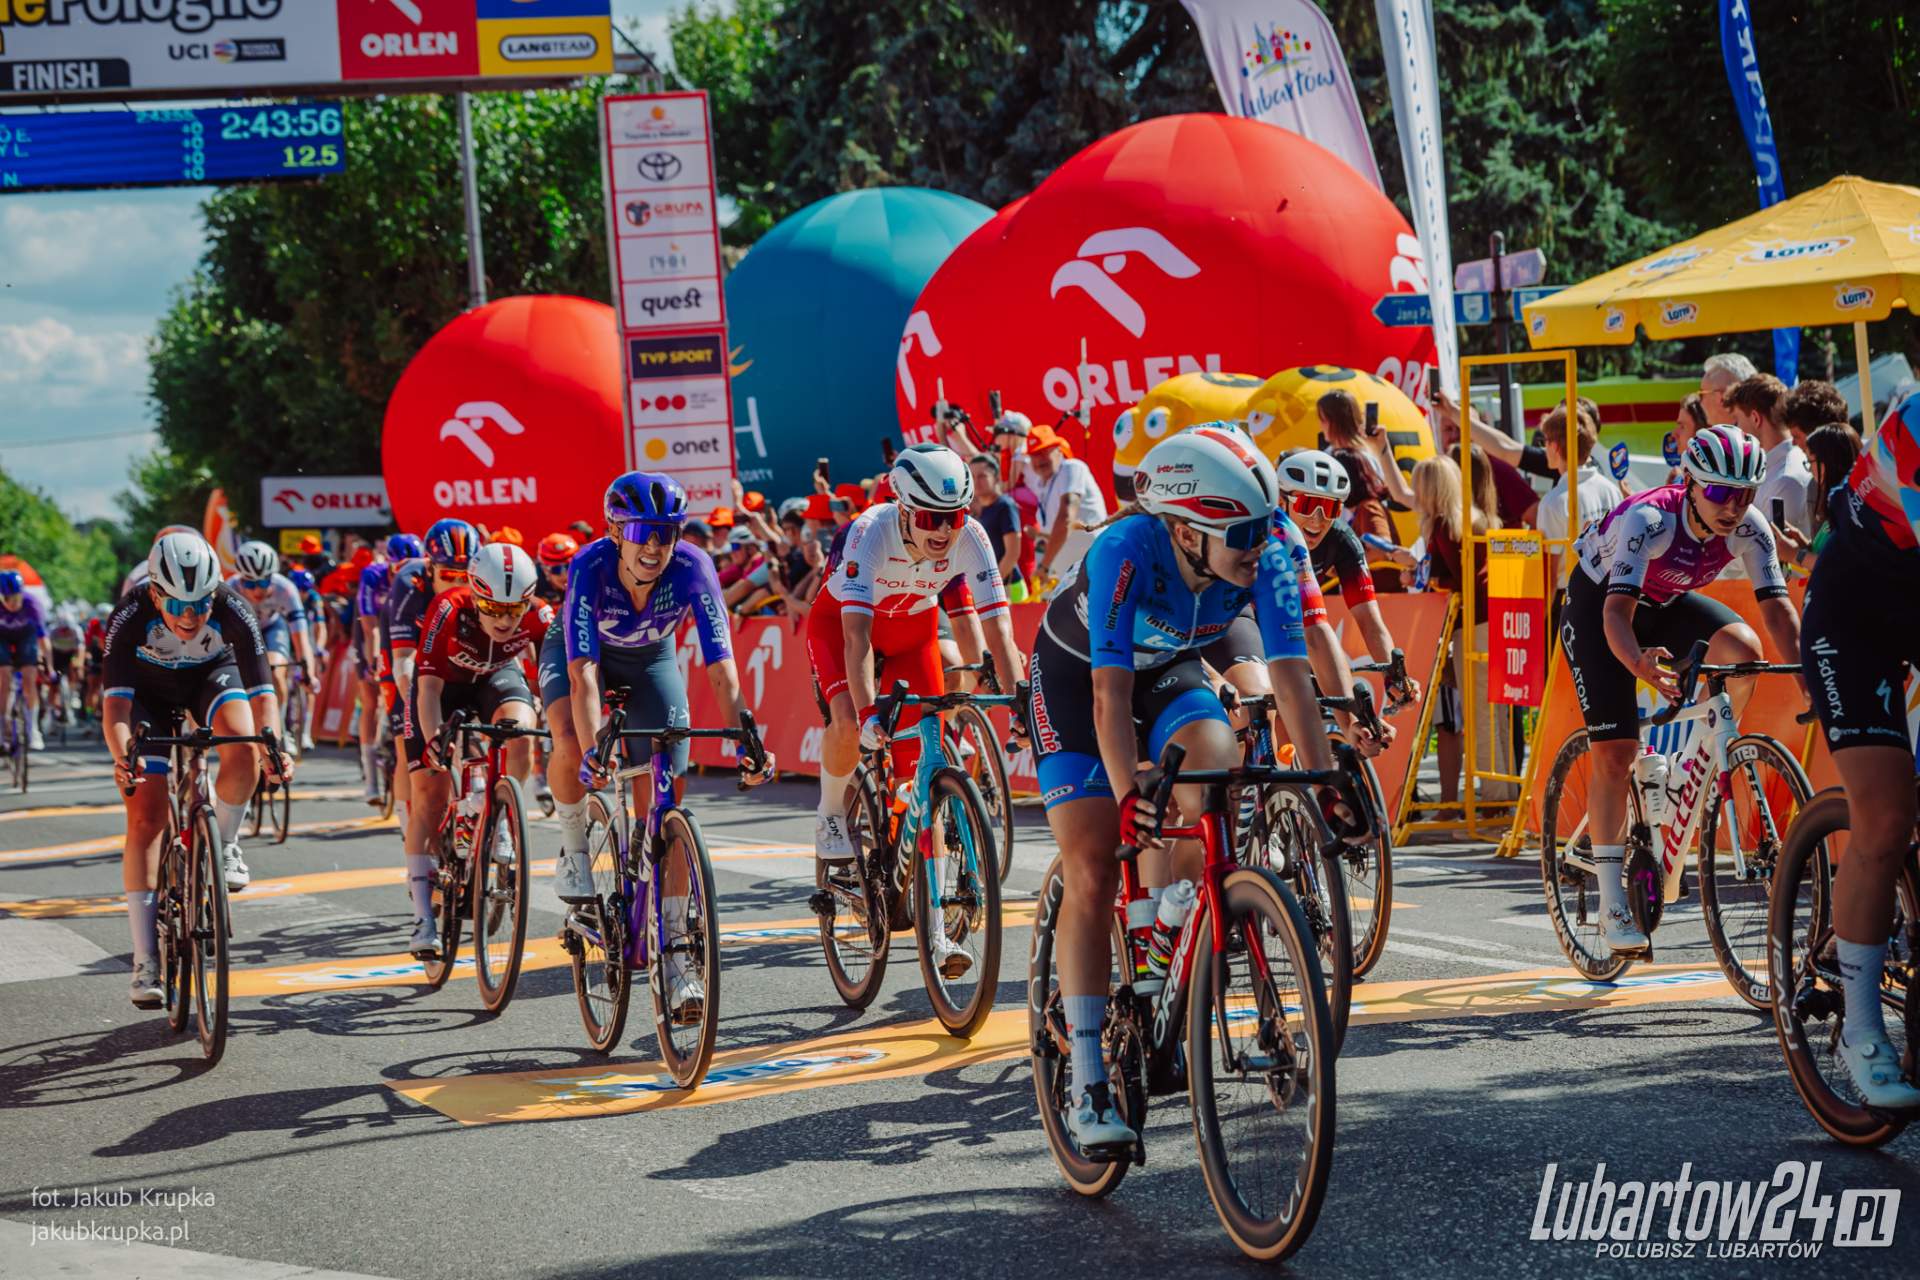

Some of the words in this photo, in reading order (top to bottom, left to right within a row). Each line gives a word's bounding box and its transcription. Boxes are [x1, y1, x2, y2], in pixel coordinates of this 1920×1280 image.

[168, 44, 208, 61] UCI
[360, 31, 458, 58] ORLEN
[507, 41, 591, 54] LANGTEAM
[12, 62, 99, 90] FINISH
[220, 109, 342, 139] 2:43:56
[283, 145, 339, 168] 12.5
[641, 287, 703, 318] quest
[639, 352, 667, 365] TVP
[670, 349, 713, 364] SPORT
[1042, 354, 1222, 412] ORLEN
[672, 437, 720, 455] onet
[312, 493, 383, 510] ORLEN
[433, 476, 538, 509] ORLEN
[1645, 519, 1664, 534] ATOM
[575, 595, 593, 654] Jayco
[604, 607, 629, 616] Jayco
[700, 593, 730, 650] Jayco
[597, 617, 678, 644] Liv
[1503, 611, 1531, 640] CLUB
[1506, 648, 1528, 675] TDP
[1503, 683, 1523, 702] Stage
[1524, 685, 1530, 700] 2
[1572, 666, 1592, 713] ATOM
[1817, 657, 1845, 719] sdworx
